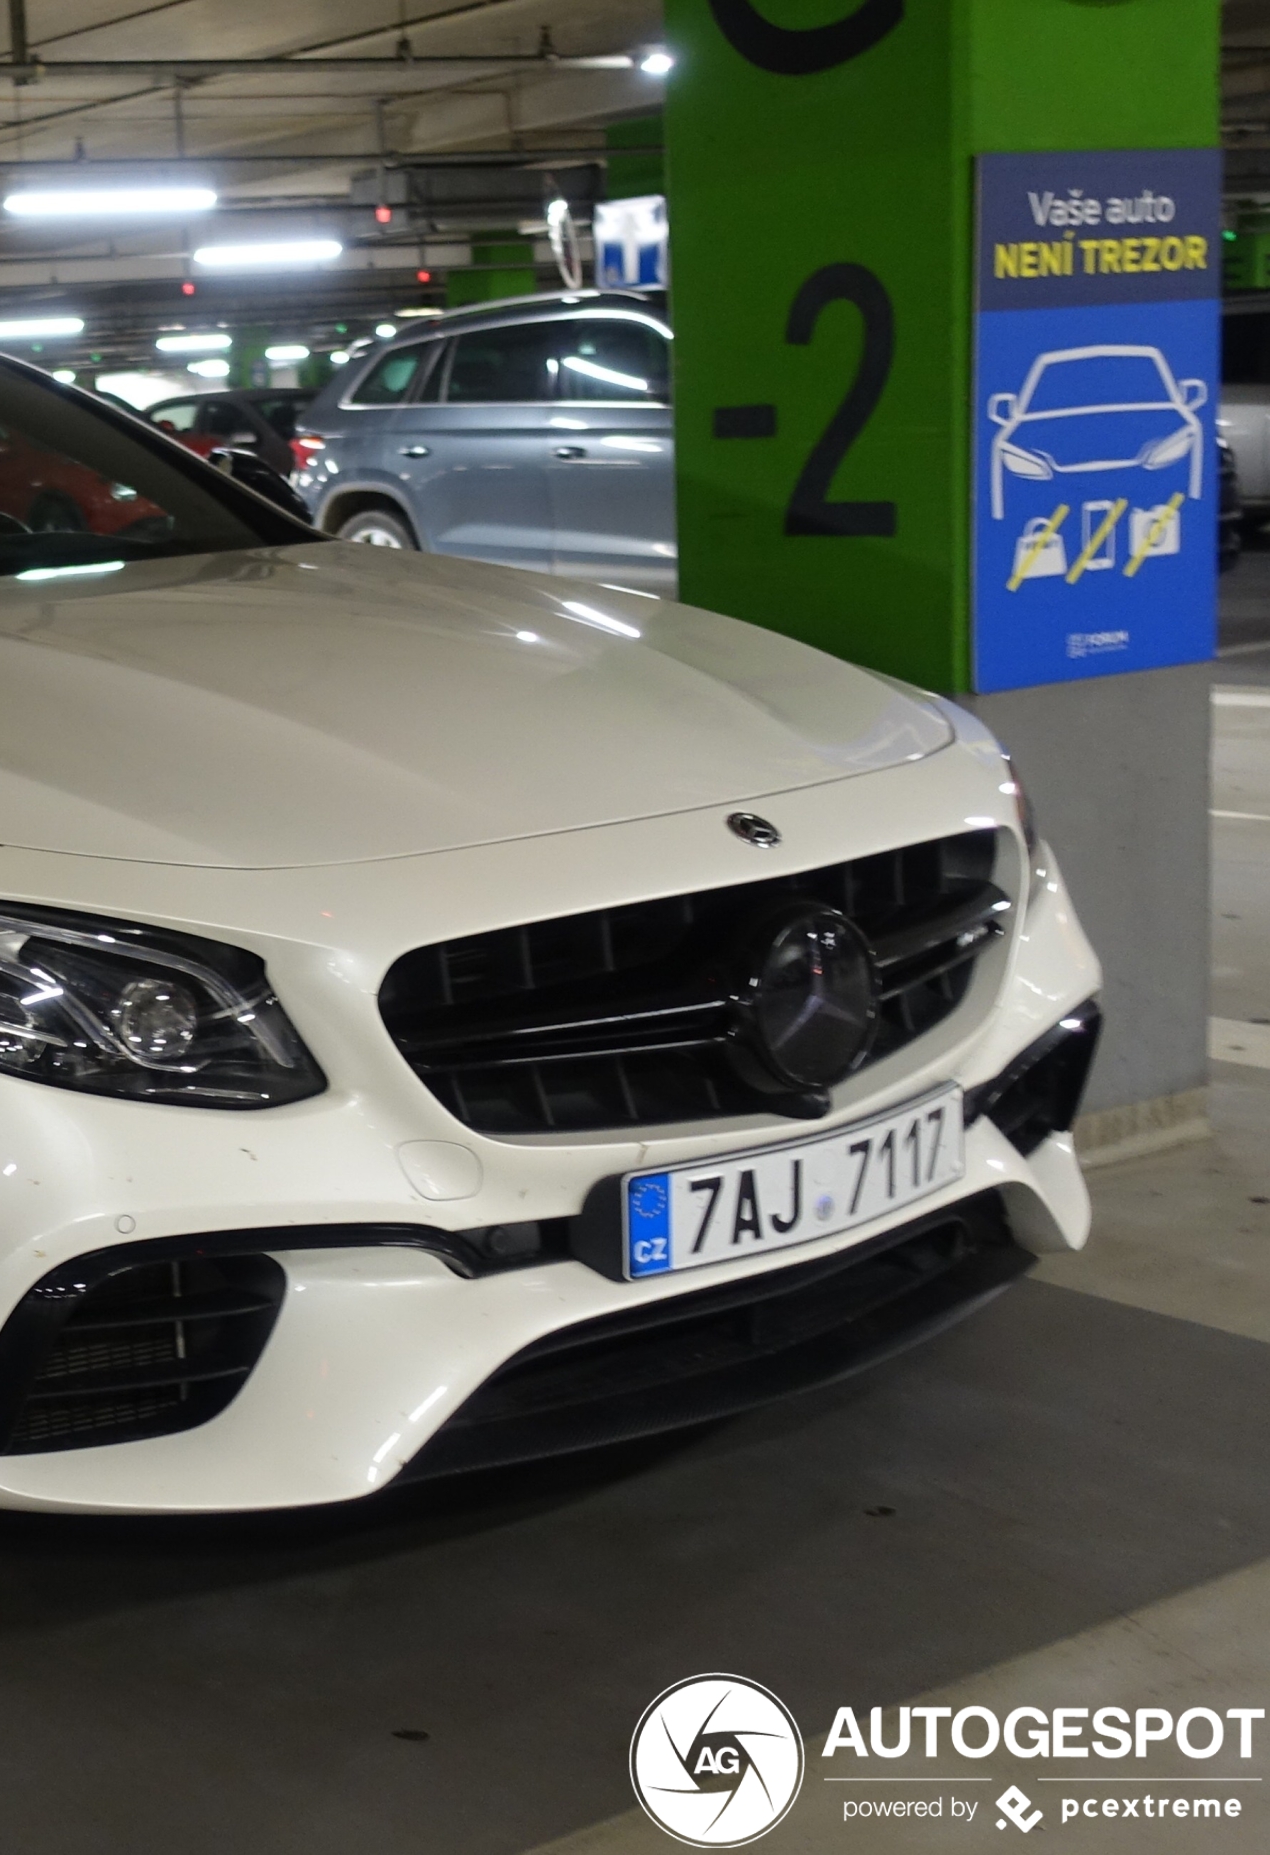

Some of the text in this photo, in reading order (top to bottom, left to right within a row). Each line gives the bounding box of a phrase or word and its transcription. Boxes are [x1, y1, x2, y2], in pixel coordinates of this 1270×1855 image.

[1028, 188, 1176, 226] Vaše auto
[994, 230, 1076, 279] NENÍ
[1078, 234, 1208, 275] TREZOR
[712, 260, 897, 538] -2
[689, 1106, 946, 1253] 7AJ 7117
[633, 1237, 668, 1264] CZ
